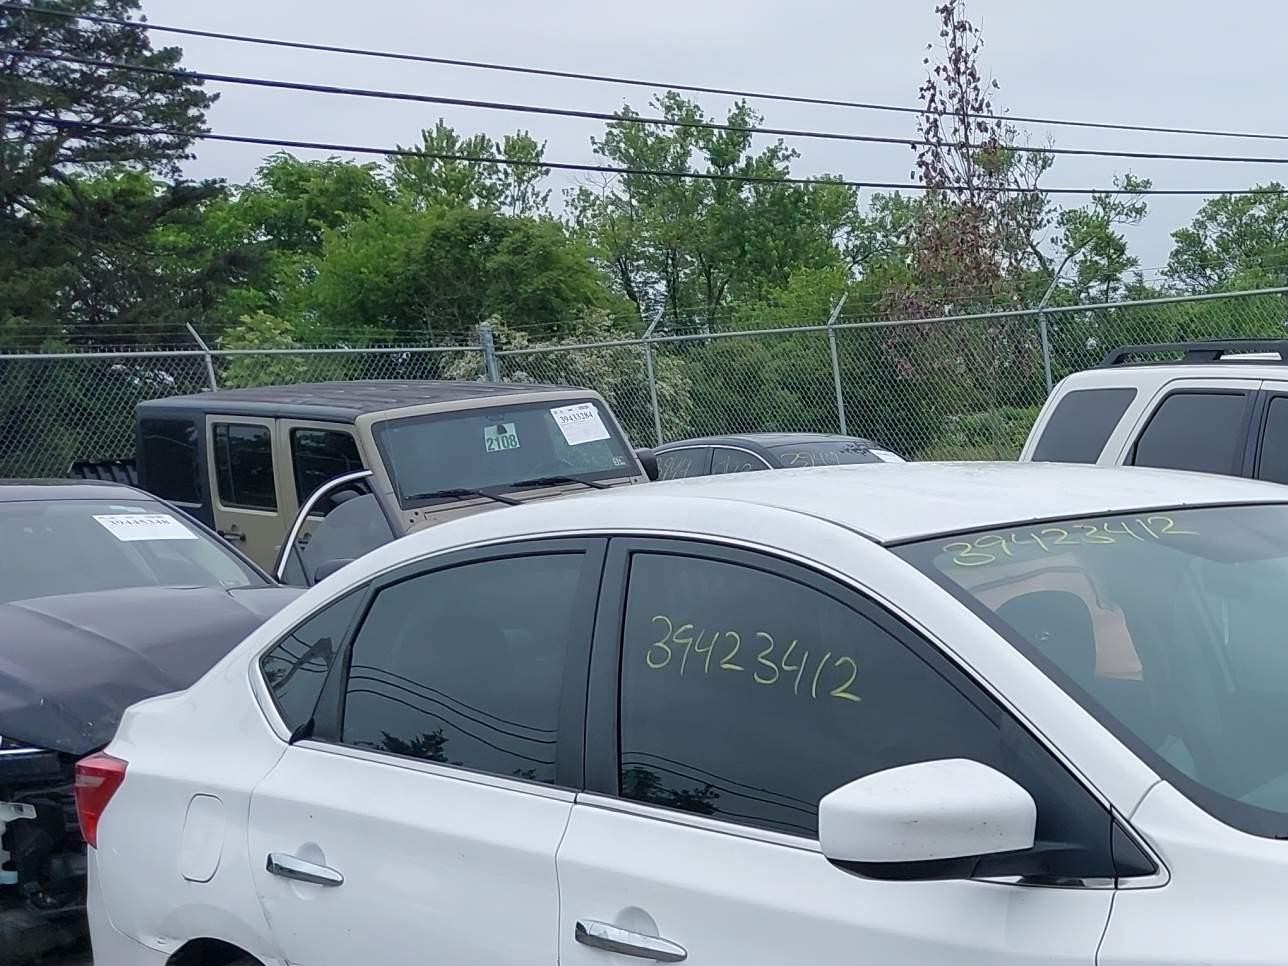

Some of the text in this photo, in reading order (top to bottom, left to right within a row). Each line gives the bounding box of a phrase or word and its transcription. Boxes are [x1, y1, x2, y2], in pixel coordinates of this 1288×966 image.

[486, 433, 518, 451] 2108
[943, 516, 1200, 566] 39423412
[646, 615, 862, 701] 39423412
